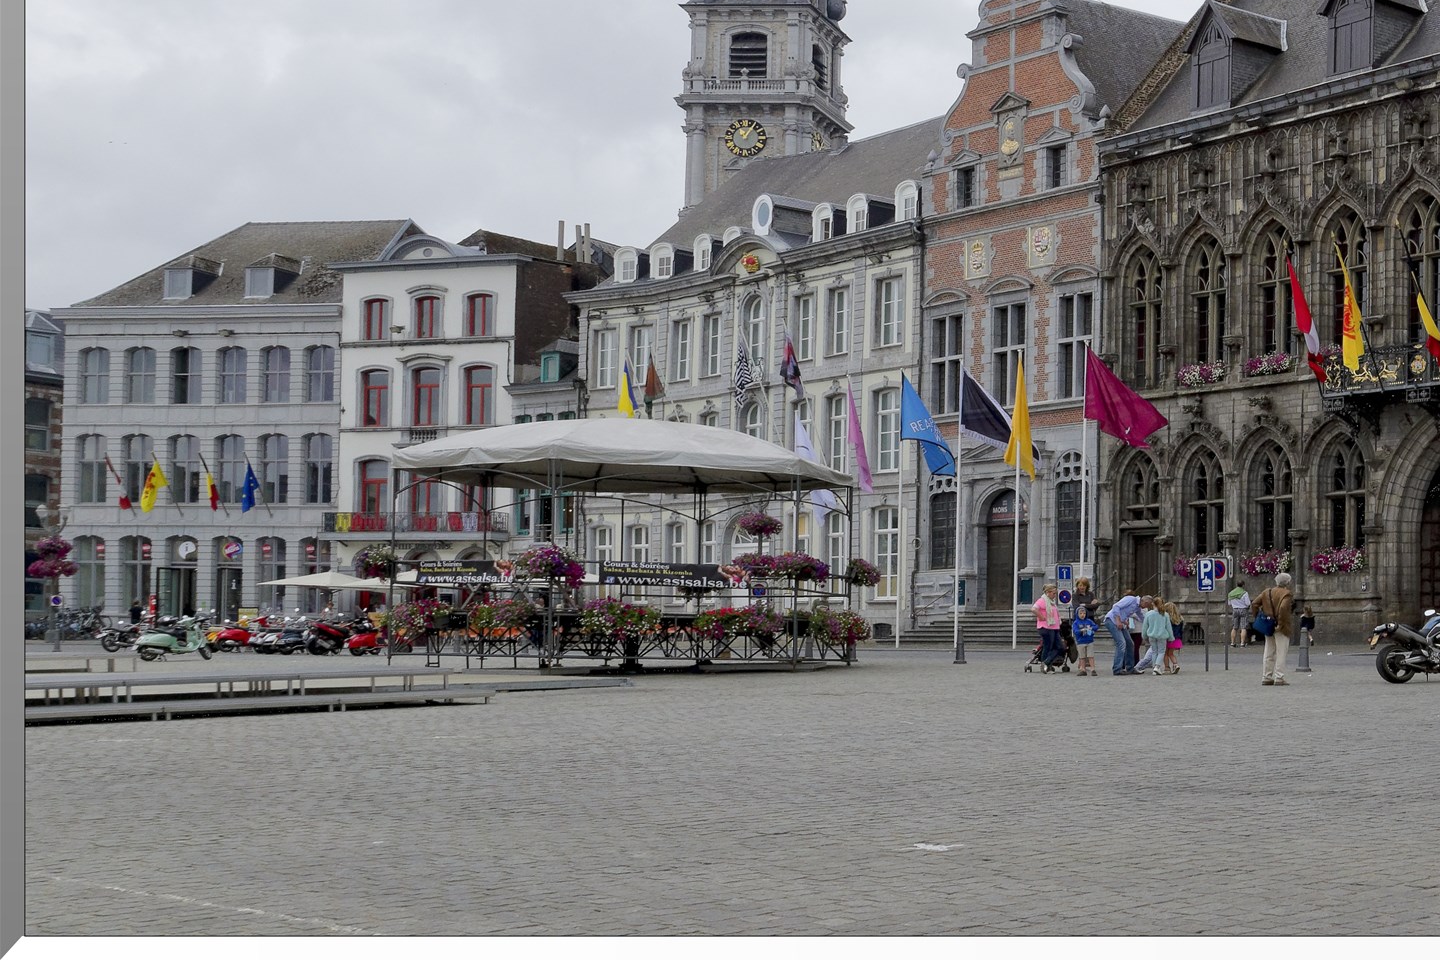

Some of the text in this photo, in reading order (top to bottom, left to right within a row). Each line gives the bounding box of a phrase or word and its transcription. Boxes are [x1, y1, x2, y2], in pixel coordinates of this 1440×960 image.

[603, 560, 629, 568] Cours
[1200, 560, 1212, 580] P
[428, 572, 513, 583] www.asisalsa.be
[618, 575, 747, 589] www.asisalsa.be
